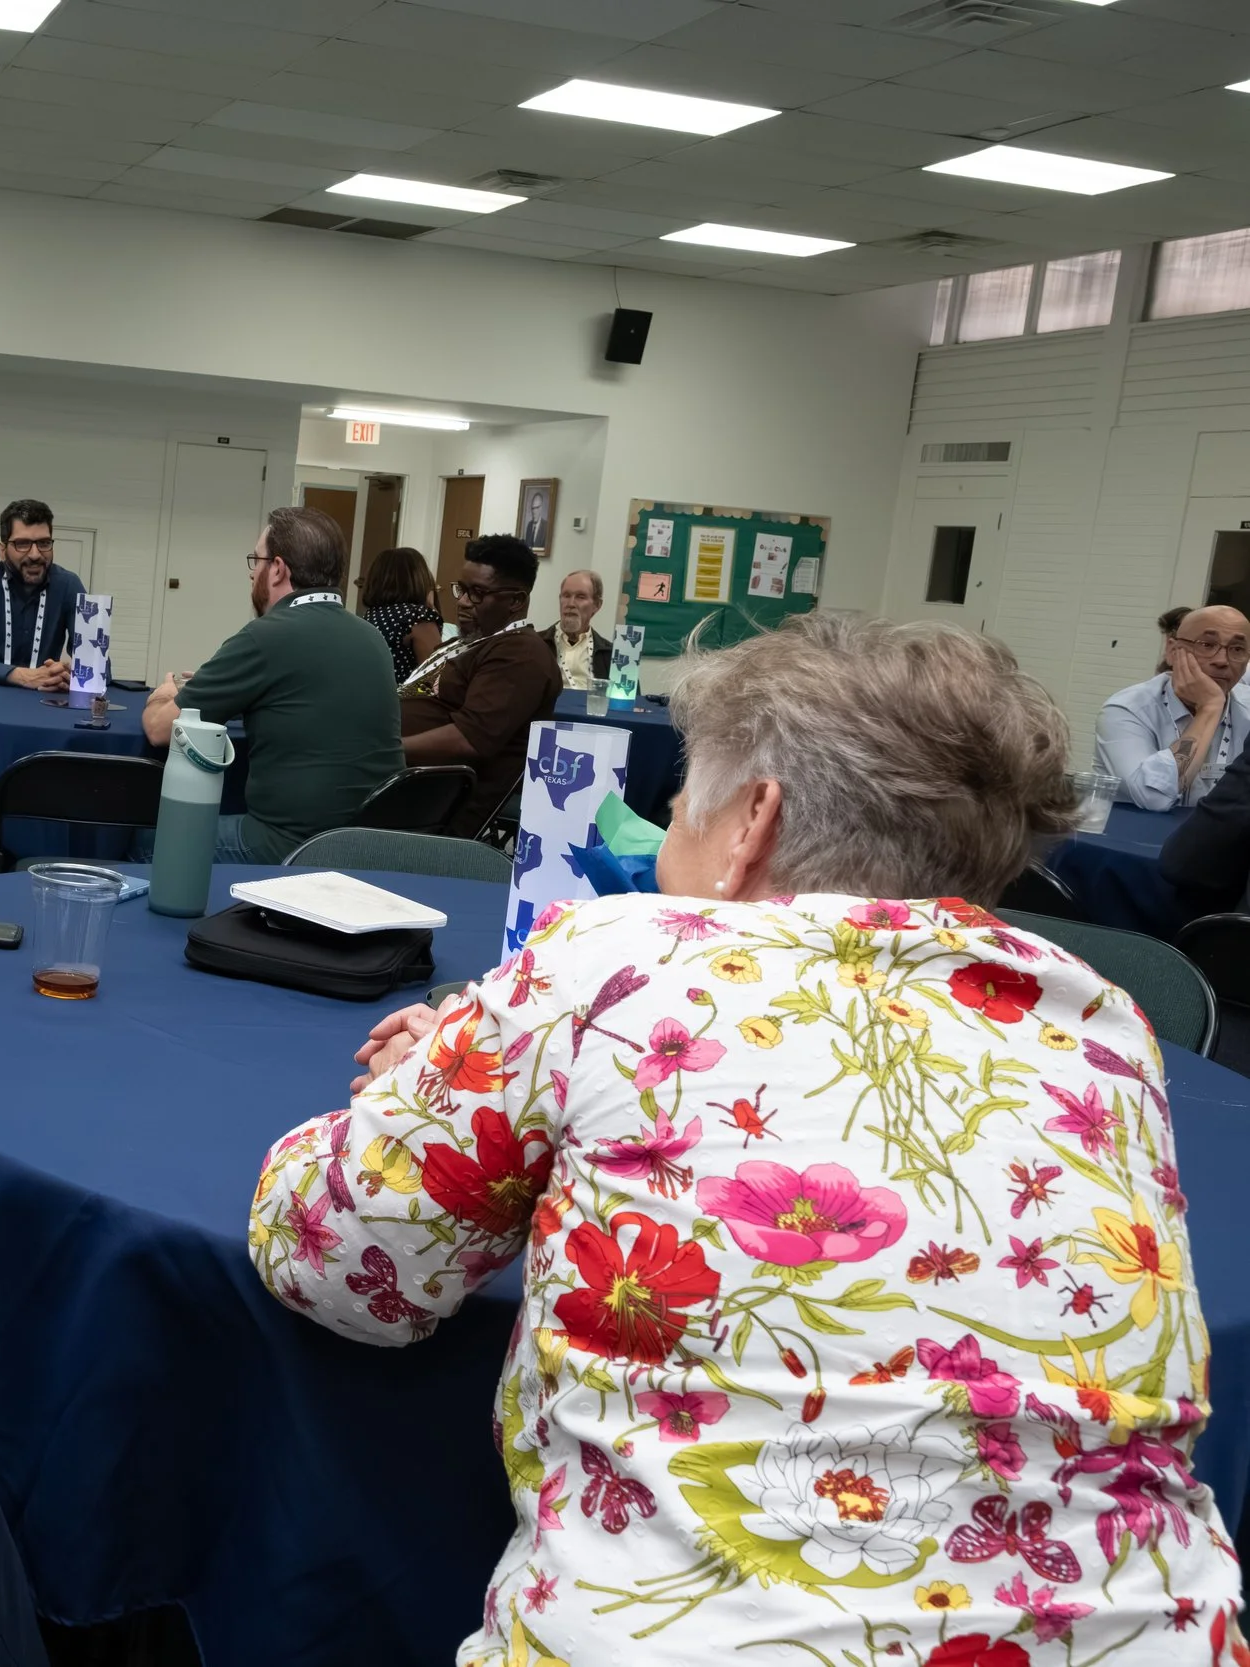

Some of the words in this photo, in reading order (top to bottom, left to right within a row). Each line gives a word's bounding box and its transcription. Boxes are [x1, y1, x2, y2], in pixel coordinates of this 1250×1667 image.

[352, 422, 375, 442] EXIT
[538, 745, 585, 785] cbf
[544, 775, 568, 786] TEXAS
